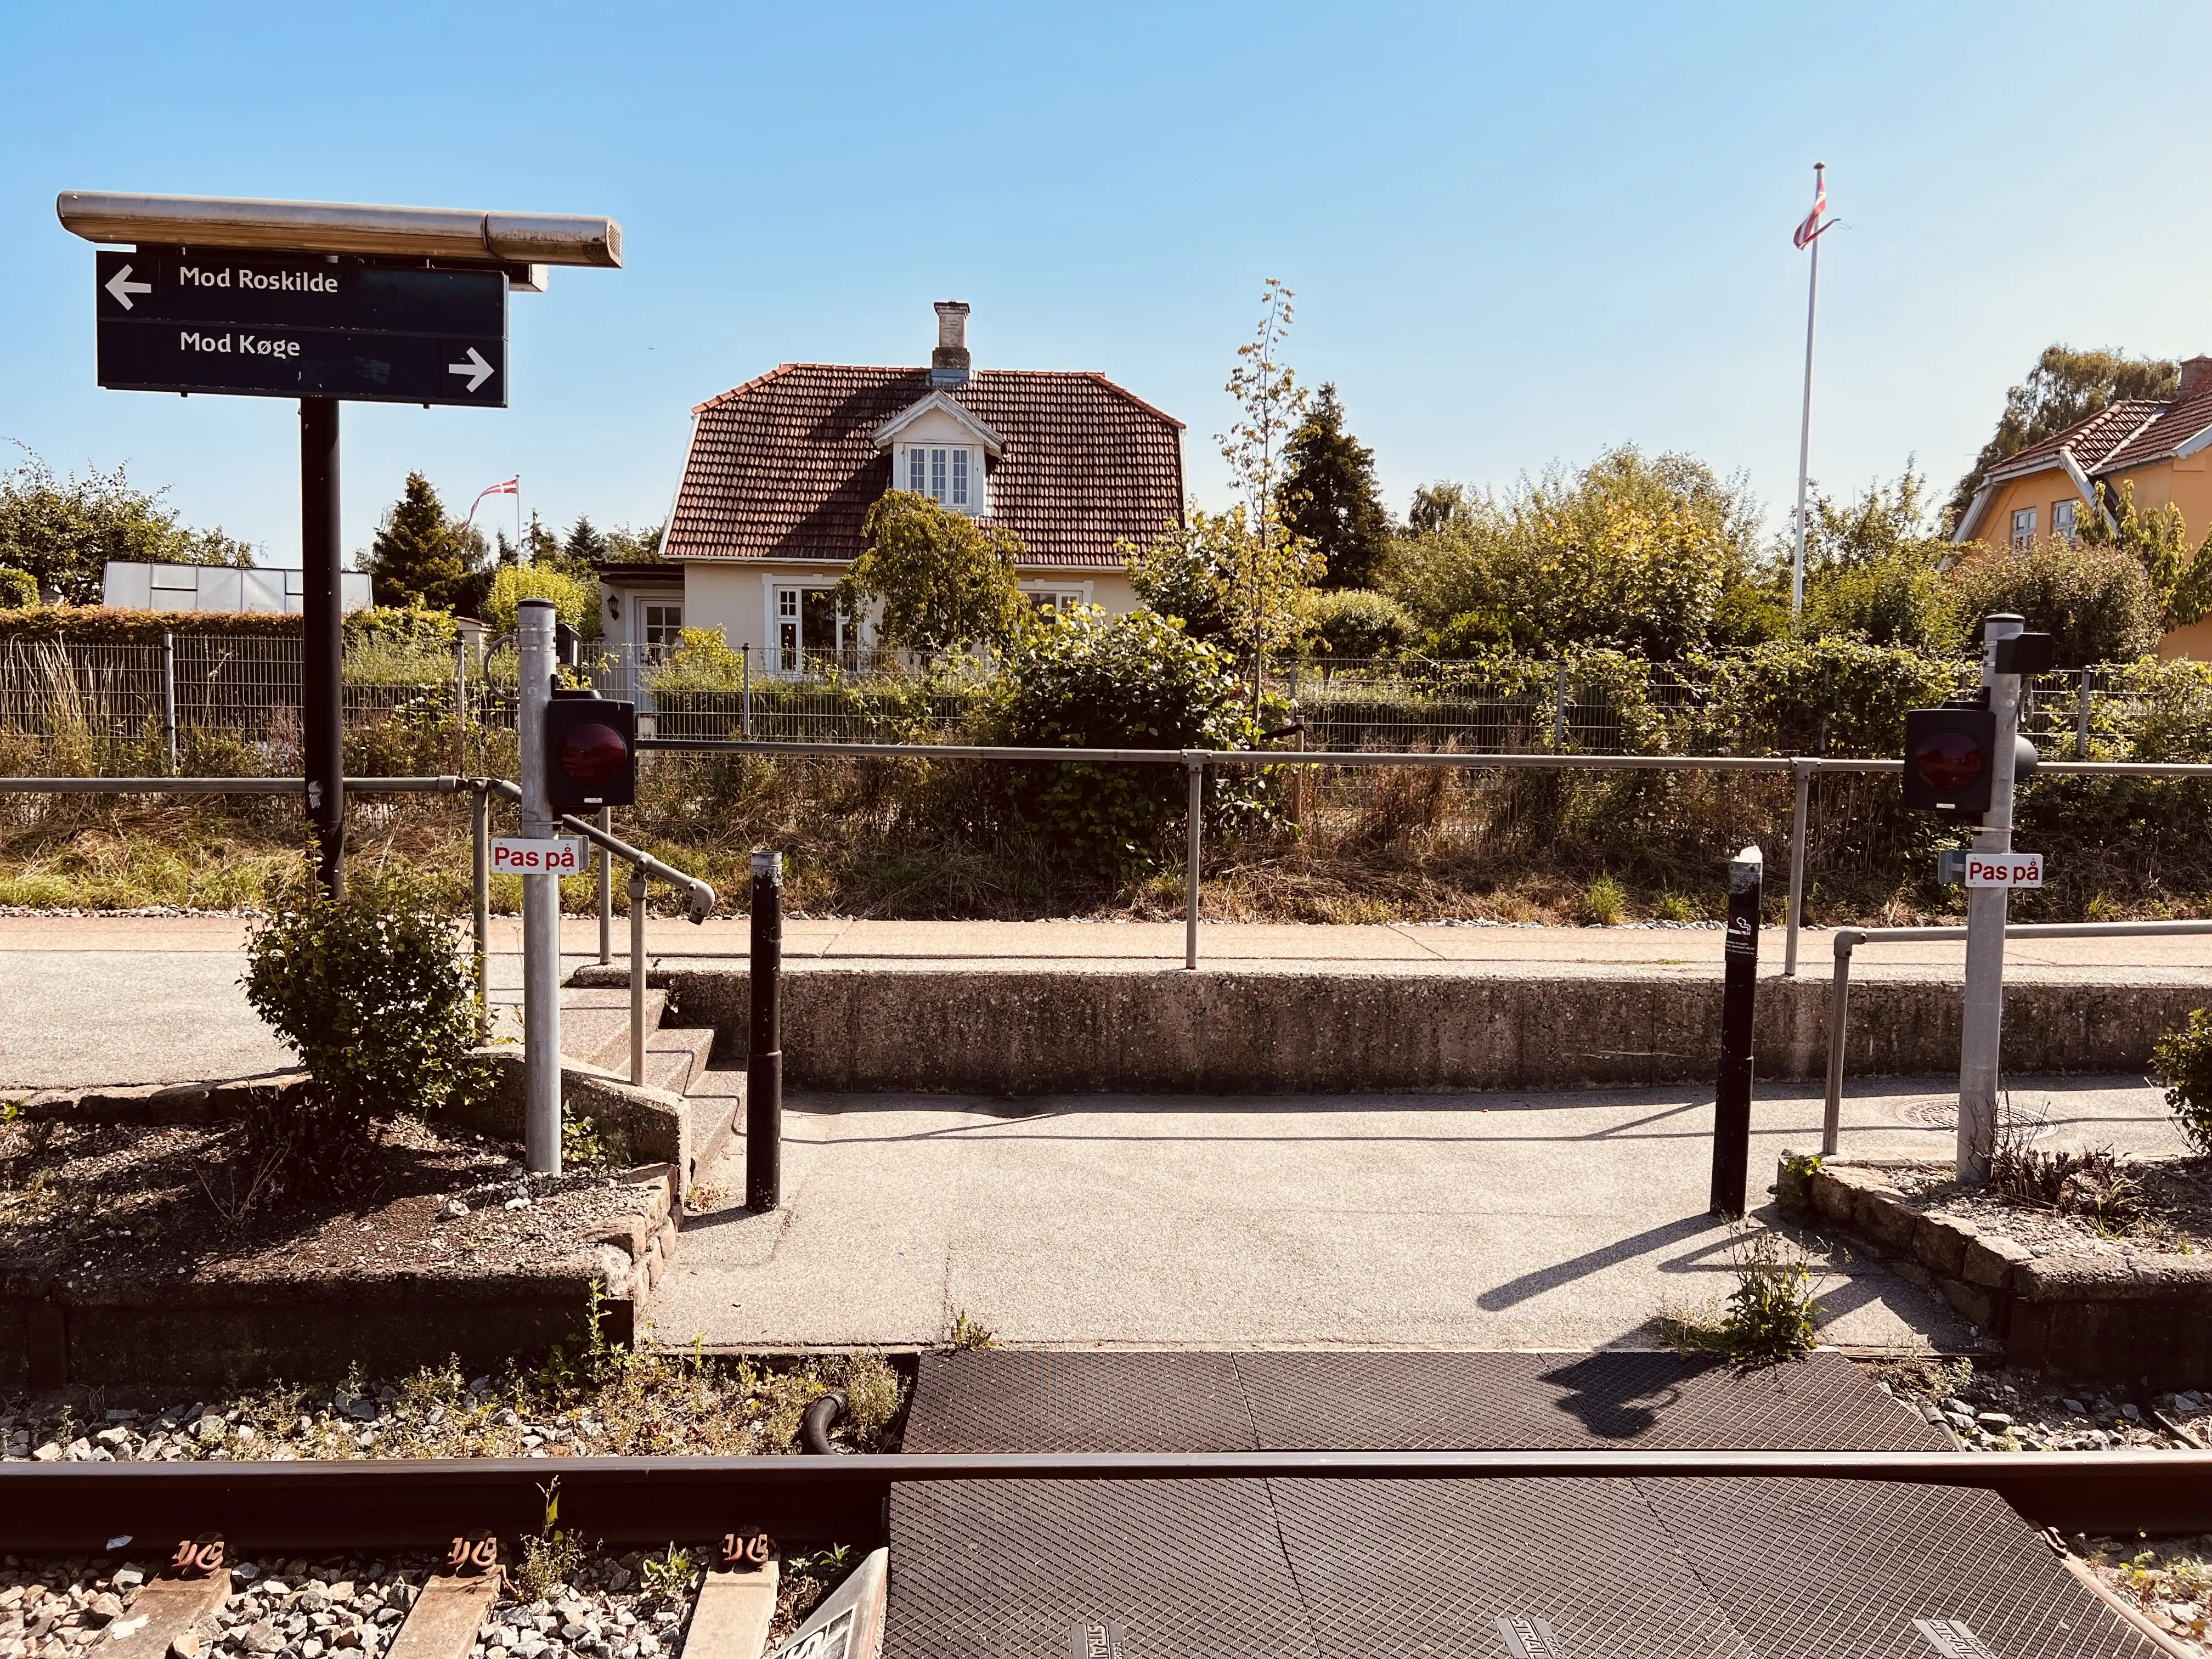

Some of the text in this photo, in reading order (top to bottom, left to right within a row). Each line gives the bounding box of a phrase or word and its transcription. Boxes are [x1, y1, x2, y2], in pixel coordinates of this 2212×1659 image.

[180, 267, 338, 292] Mod Roskilde
[180, 332, 300, 359] Mod Køge
[495, 847, 574, 871] Pas på
[1970, 861, 2039, 884] Pas på
[1087, 1624, 1108, 1659] STRAI
